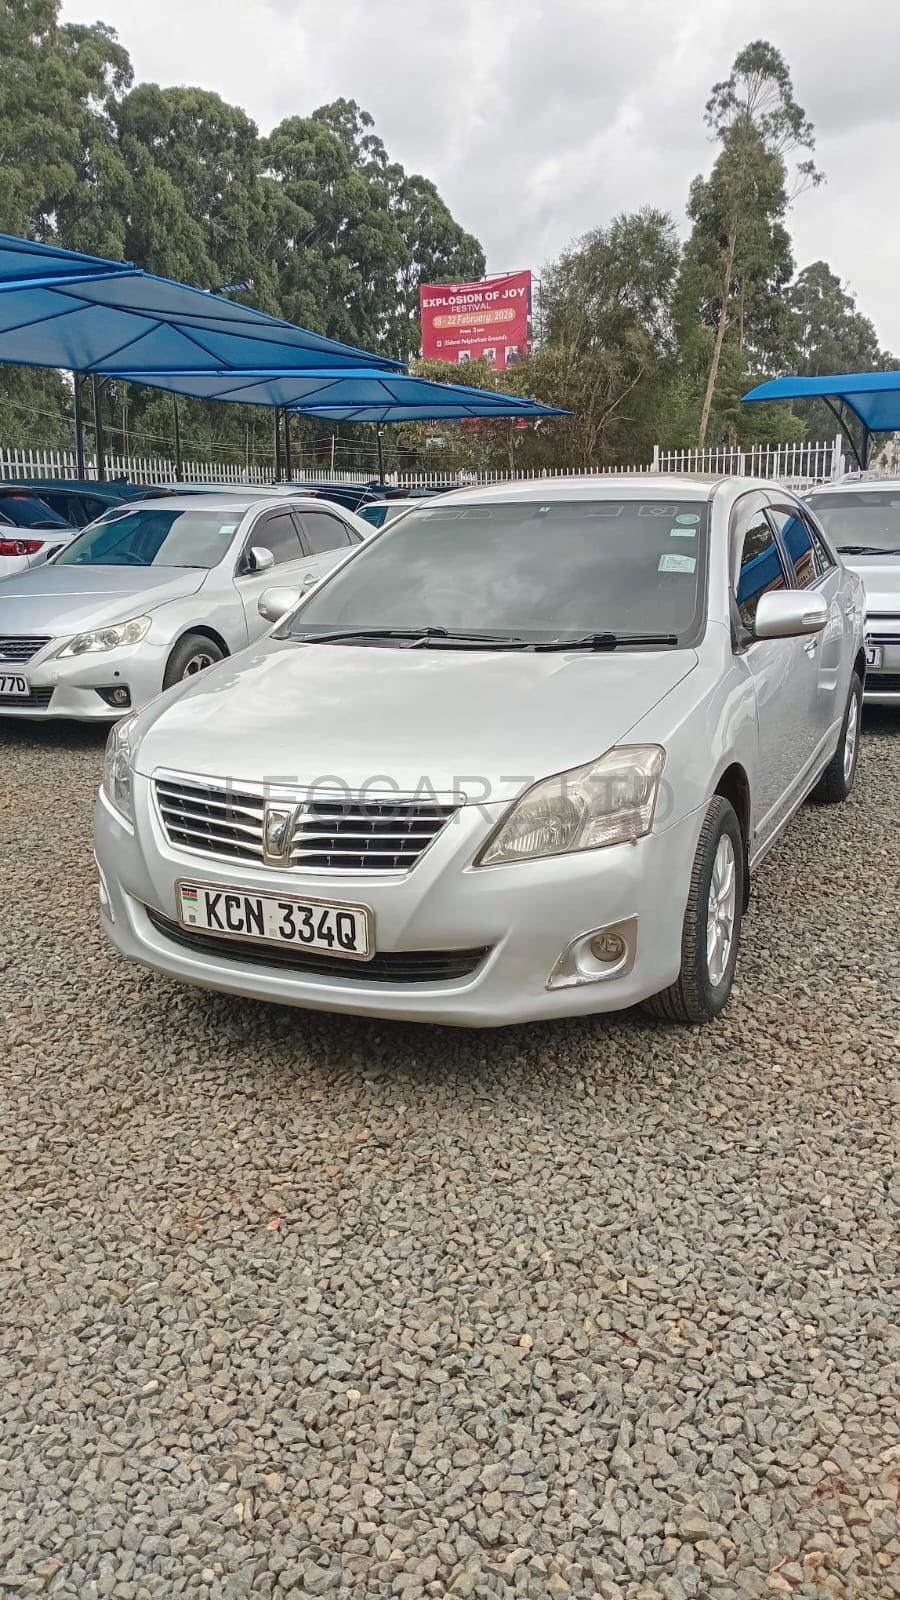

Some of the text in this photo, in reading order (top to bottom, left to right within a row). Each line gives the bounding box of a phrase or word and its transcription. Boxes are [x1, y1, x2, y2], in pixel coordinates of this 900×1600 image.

[422, 288, 525, 308] EXPLOSION OF JOY
[451, 303, 491, 313] FESTIVAL
[434, 317, 442, 326] 18
[447, 316, 456, 325] 22
[494, 309, 513, 320] 2026
[204, 891, 357, 951] KCN 334Q
